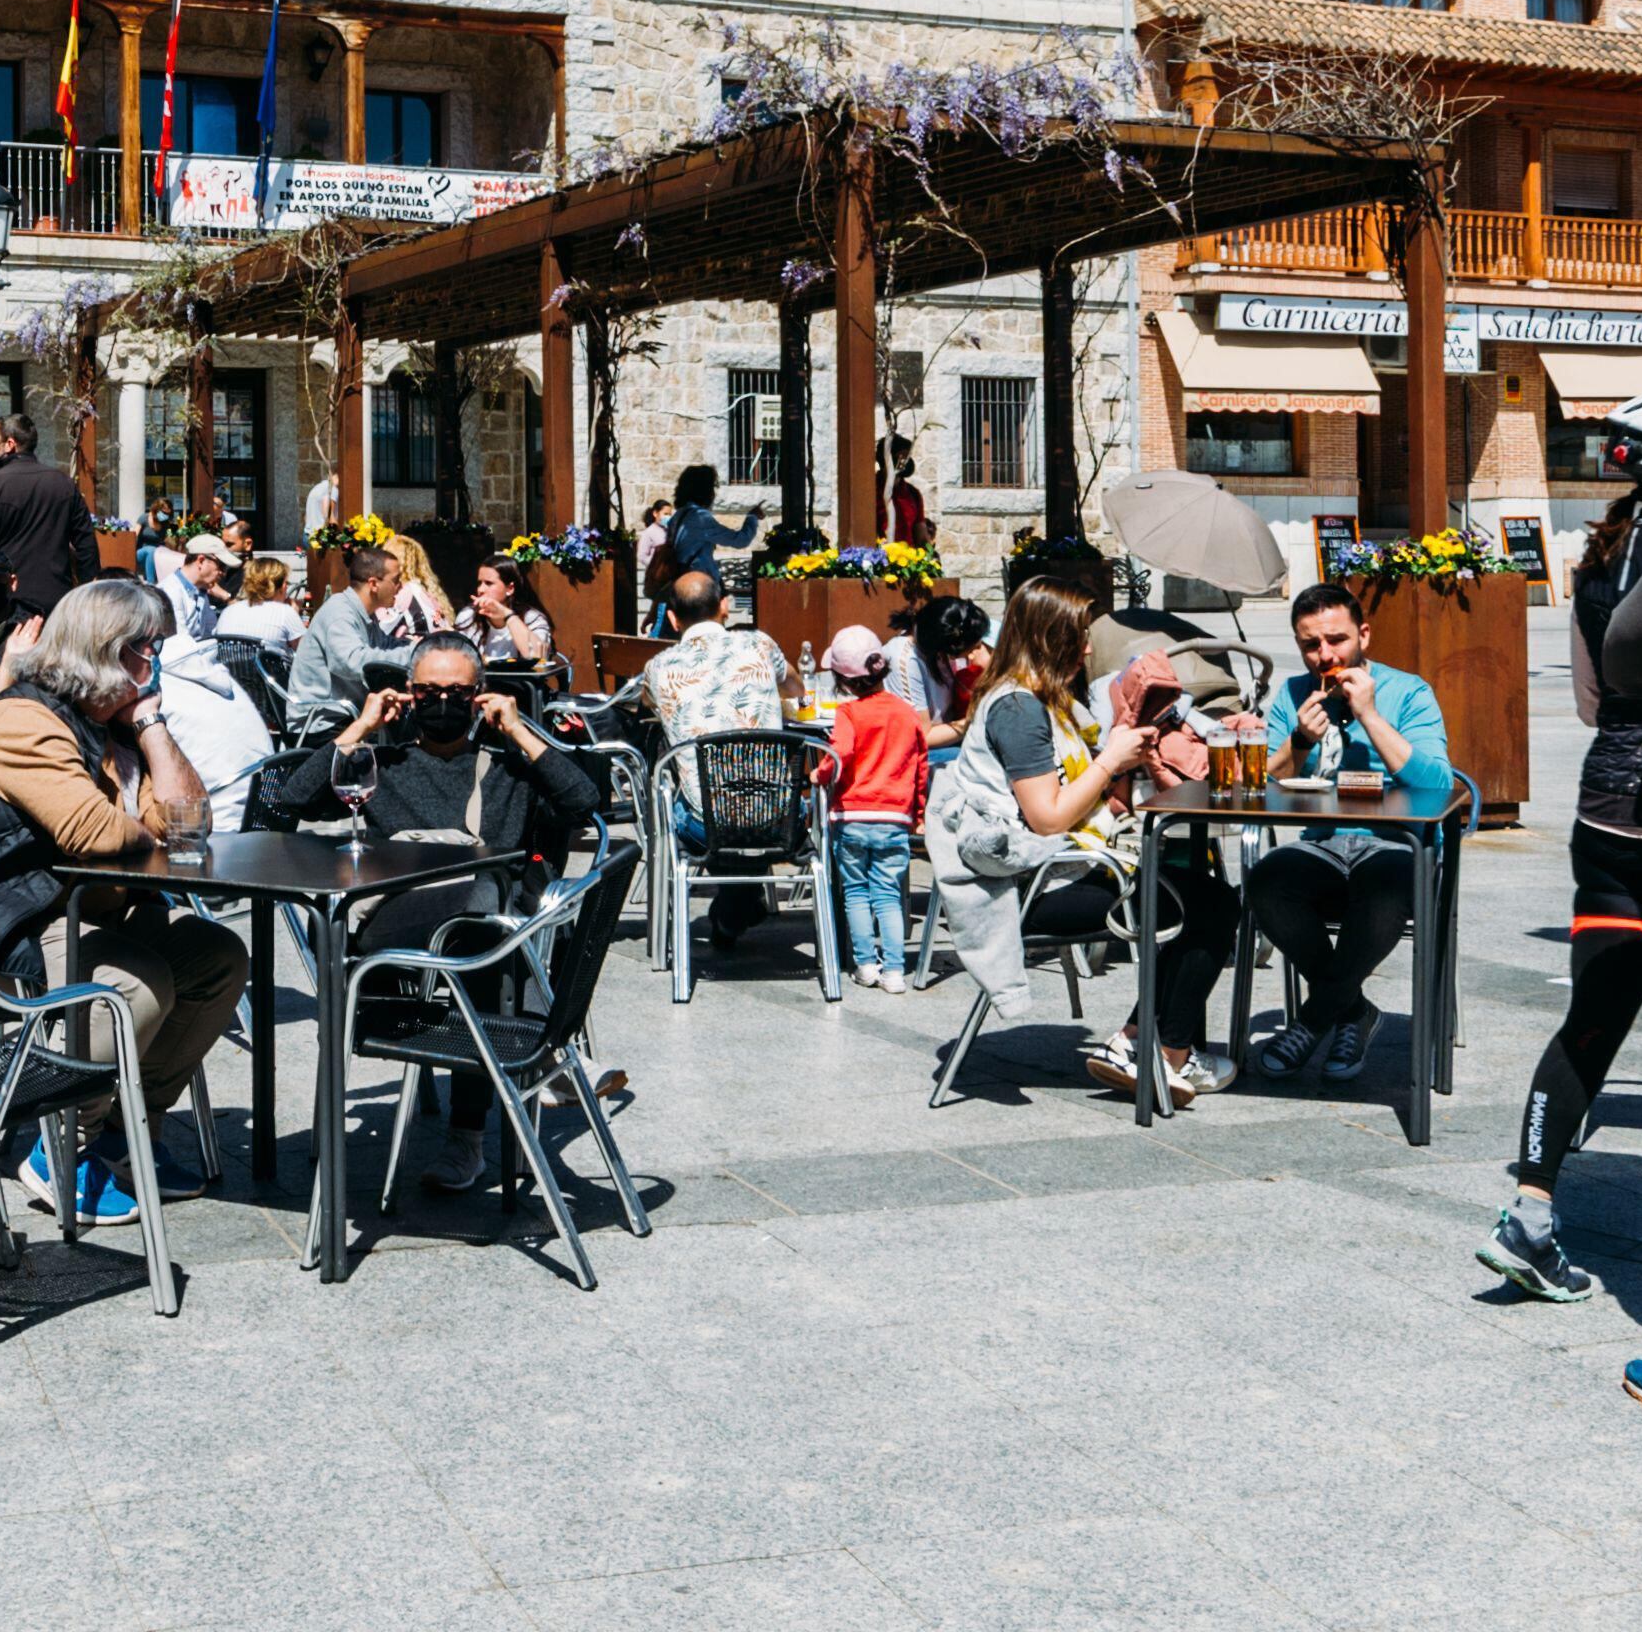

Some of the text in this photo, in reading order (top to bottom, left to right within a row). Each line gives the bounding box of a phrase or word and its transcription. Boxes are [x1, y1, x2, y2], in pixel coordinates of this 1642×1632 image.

[286, 179, 311, 189] POR
[315, 180, 337, 189] LOS
[280, 191, 430, 207] EN APOYO A LAS FAMILIAS
[276, 203, 283, 213] Y
[288, 204, 308, 213] LAS
[376, 208, 434, 220] ENFERMAS
[1242, 298, 1401, 334] Carnicería
[1443, 348, 1474, 358] AZA
[1527, 1090, 1548, 1164] NORTHWAVE
